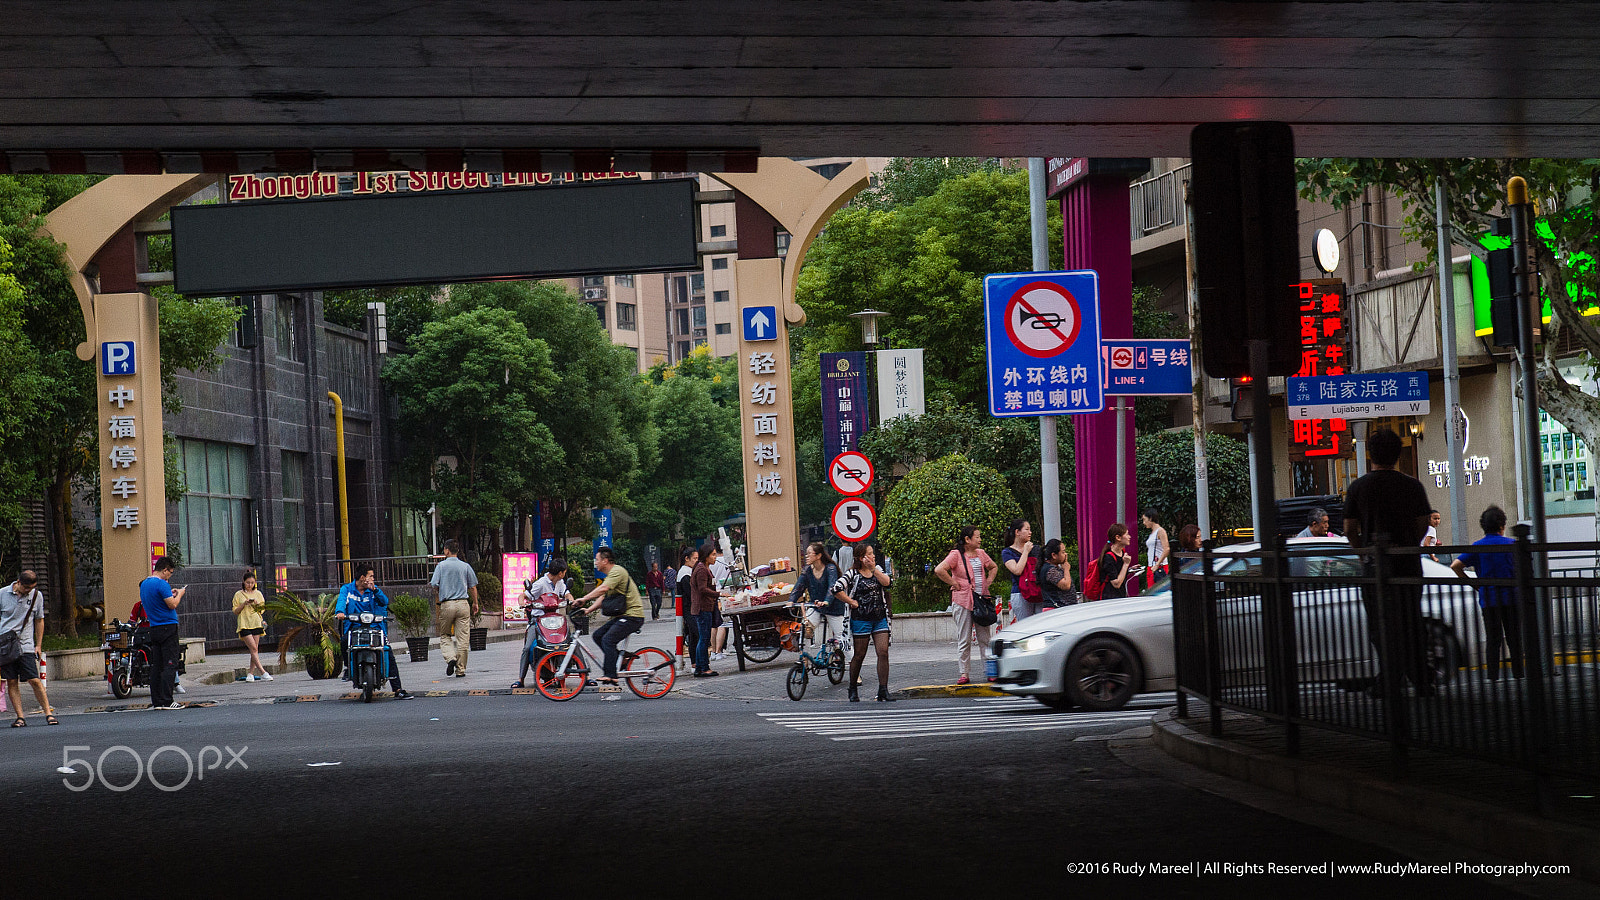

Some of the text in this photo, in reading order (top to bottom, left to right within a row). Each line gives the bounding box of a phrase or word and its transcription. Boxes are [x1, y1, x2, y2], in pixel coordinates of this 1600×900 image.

[229, 171, 338, 200] Zhongfu
[353, 171, 397, 194] 1st
[408, 171, 490, 191] Street
[107, 342, 130, 373] P
[1003, 363, 1088, 387] 外环线内
[1114, 376, 1145, 385] LINE 4
[1004, 388, 1090, 410] 禁鸣喇叭
[1296, 389, 1421, 402] 378 418
[1297, 376, 1419, 400] 东 陆家浜路 西
[1300, 407, 1308, 417] E
[1332, 403, 1370, 415] Lujiabang
[1409, 402, 1420, 412] W
[749, 351, 783, 496] 轻纺面料城
[108, 384, 140, 529] 中福停车库
[846, 505, 862, 533] 5
